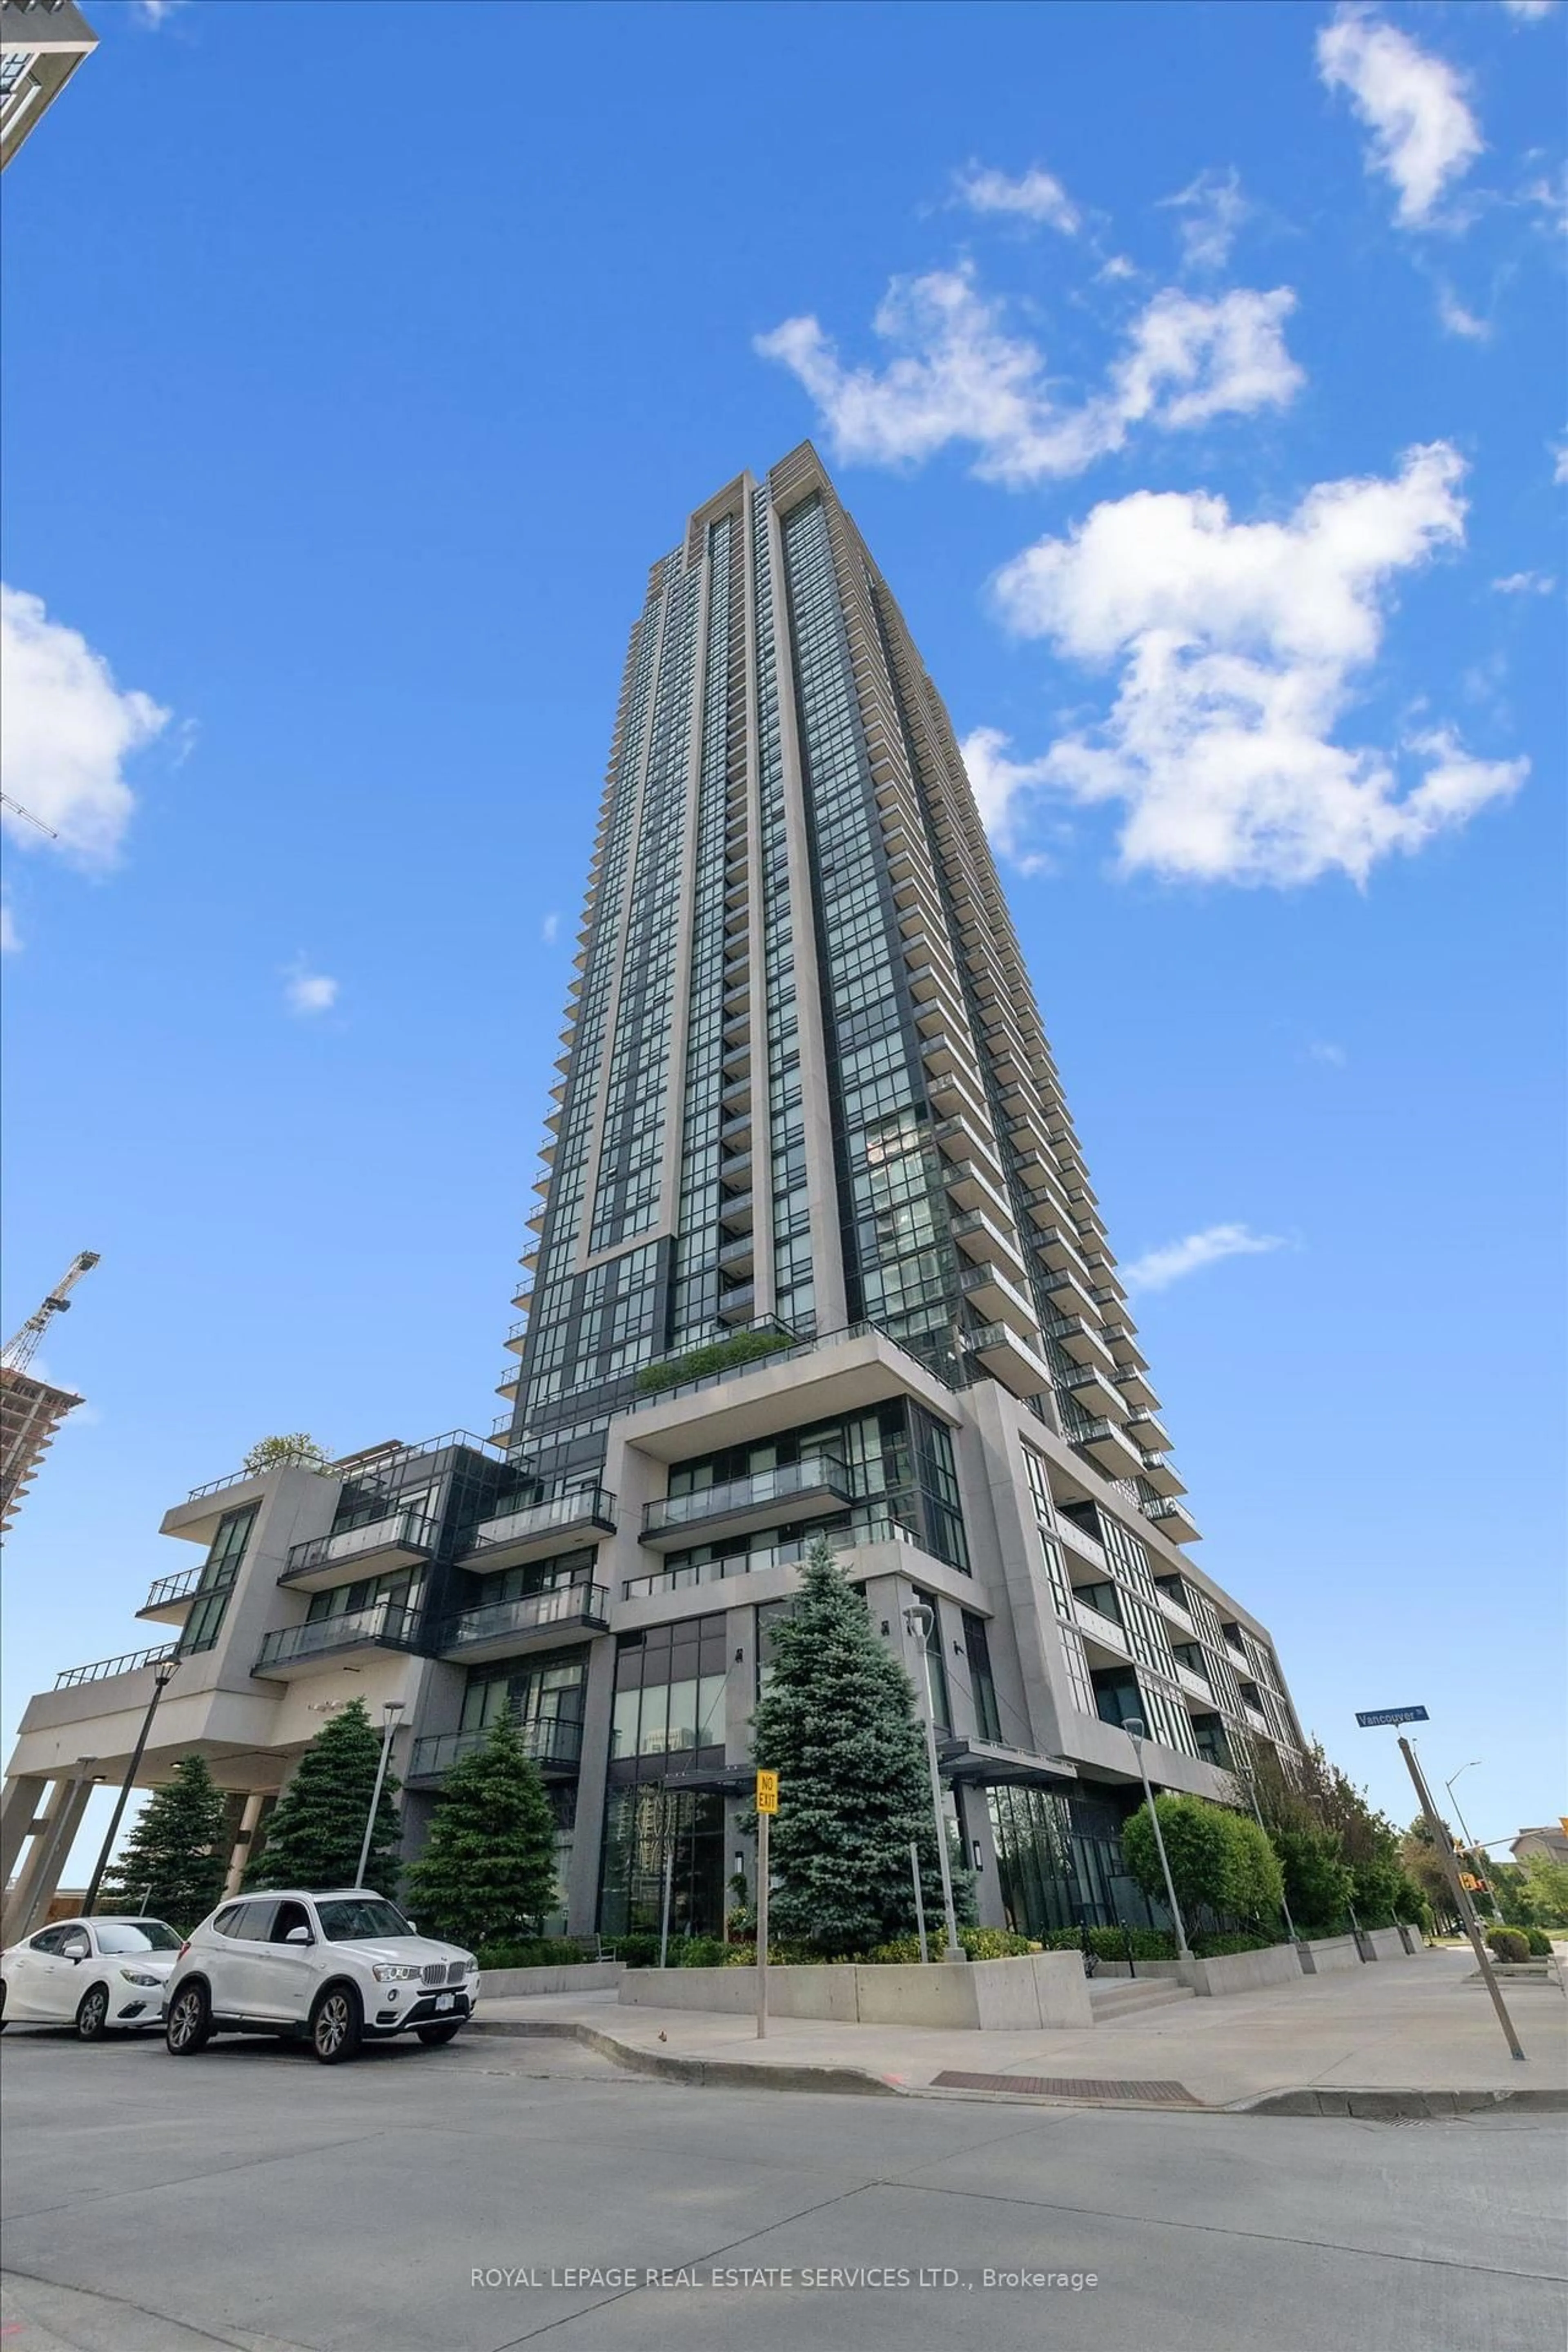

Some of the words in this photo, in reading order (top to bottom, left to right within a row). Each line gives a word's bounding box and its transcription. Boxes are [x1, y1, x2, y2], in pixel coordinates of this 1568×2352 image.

[1359, 1712, 1414, 1725] Vancouver
[762, 1775, 773, 1790] NO
[760, 1793, 775, 1809] EXIT
